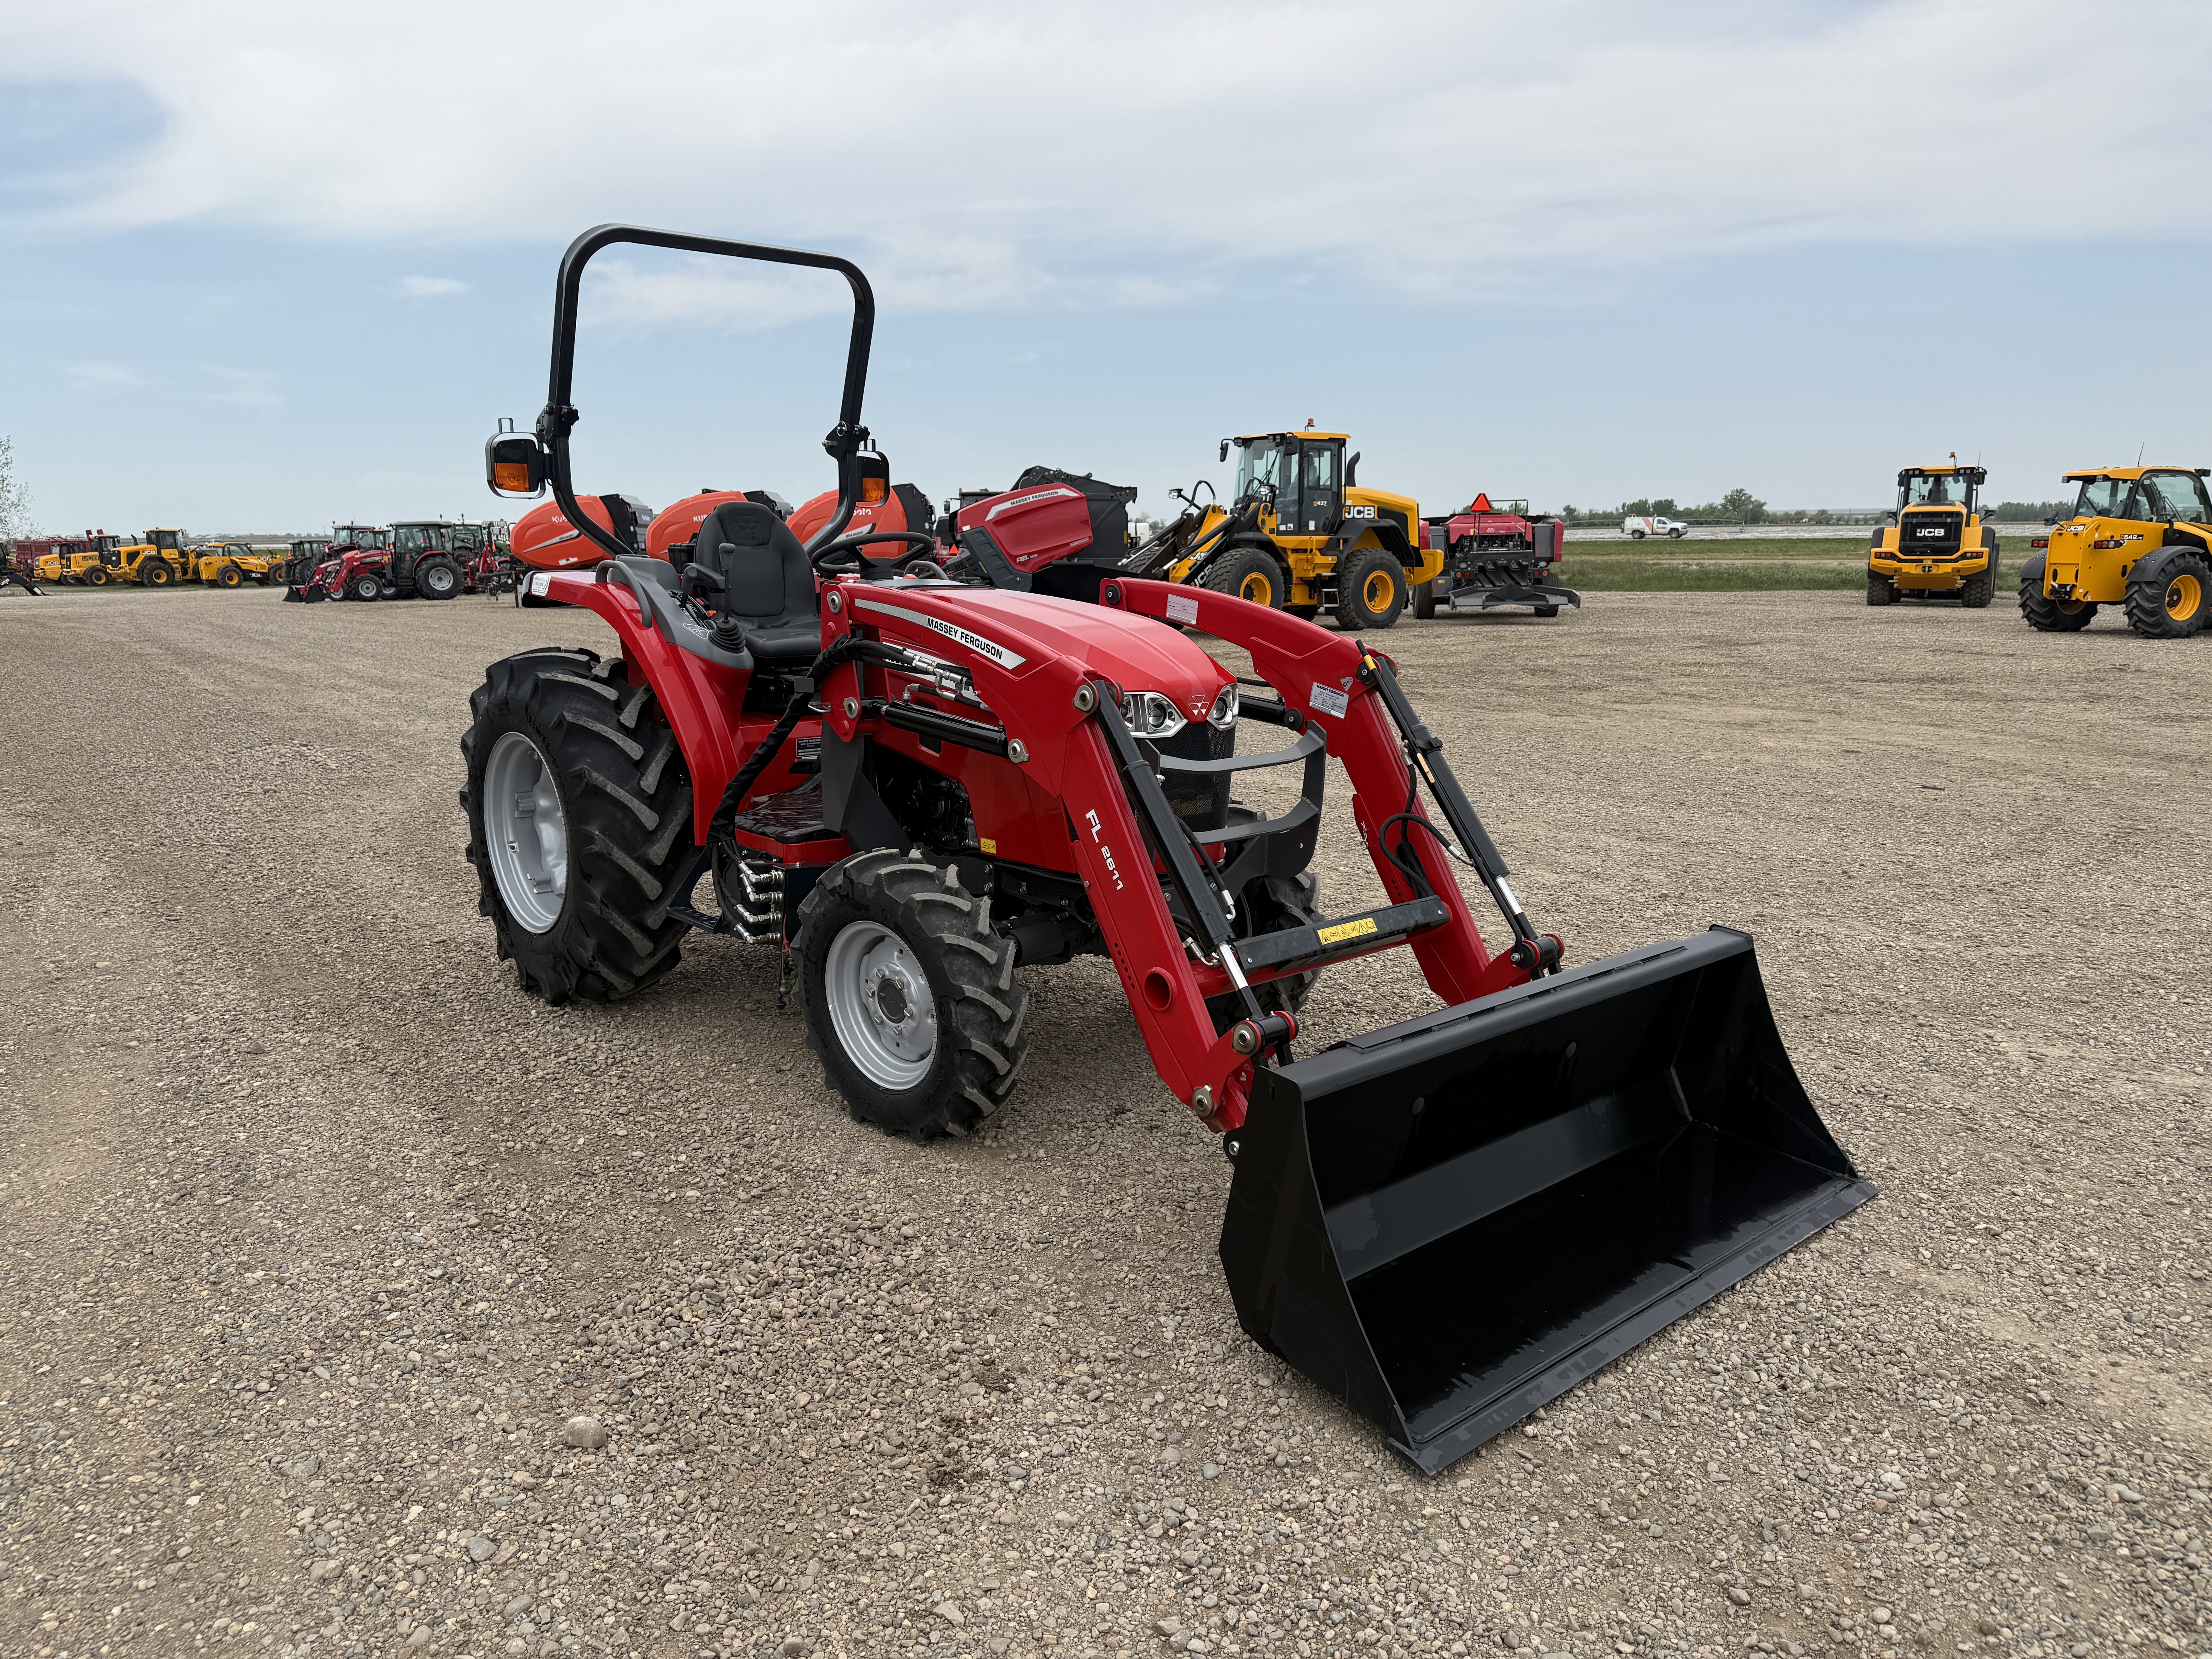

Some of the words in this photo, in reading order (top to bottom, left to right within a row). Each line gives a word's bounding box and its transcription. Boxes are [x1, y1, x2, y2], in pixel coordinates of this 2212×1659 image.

[1011, 497, 1030, 505] MASSEY
[1032, 491, 1058, 499] FERGUSON
[1345, 507, 1374, 518] JCB
[927, 617, 958, 638] MASSEY
[960, 631, 1002, 659] FERGUSON
[1085, 809, 1101, 843] FL
[1101, 845, 1123, 890] 2611
